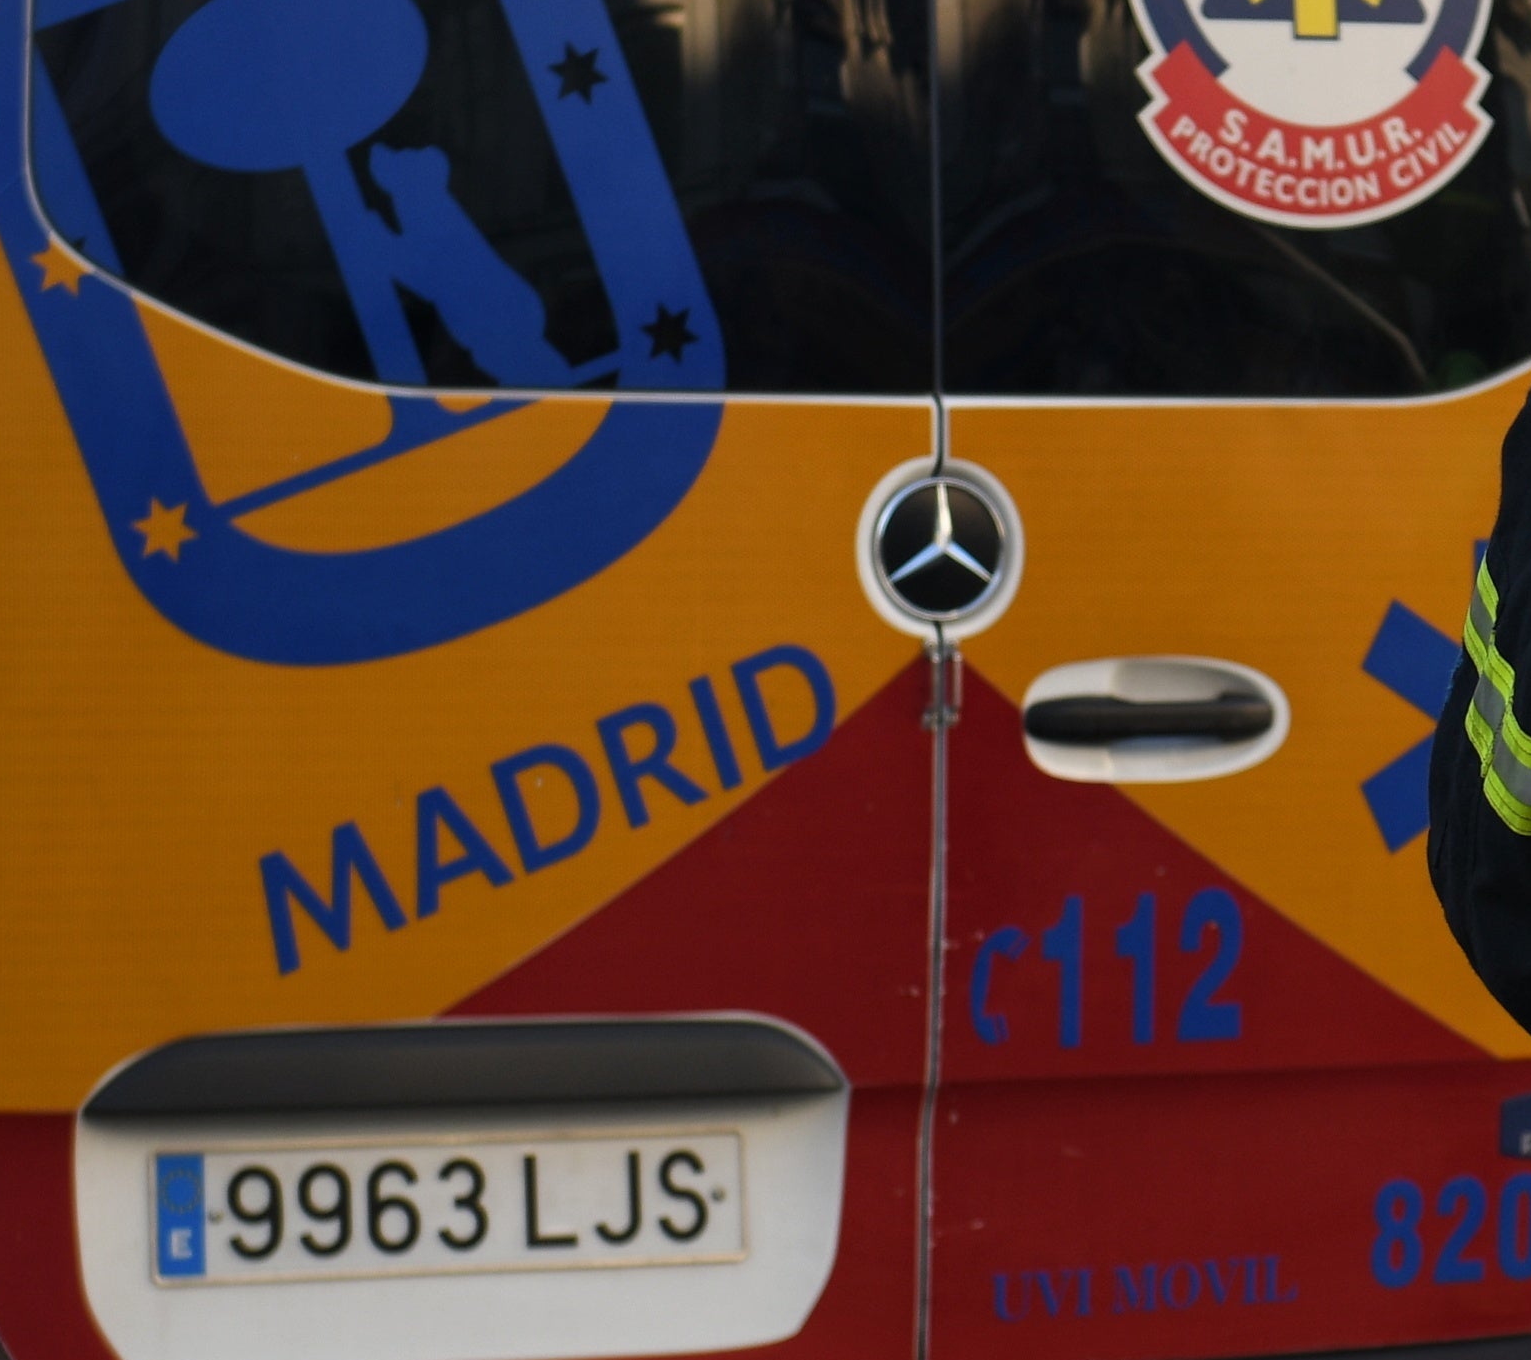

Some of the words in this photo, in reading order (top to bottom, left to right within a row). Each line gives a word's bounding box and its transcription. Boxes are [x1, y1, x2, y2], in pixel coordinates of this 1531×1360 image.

[1171, 115, 1382, 207] PROTECCION
[1388, 120, 1468, 190] CIVIL
[1218, 108, 1424, 171] S.A.M.U.R.
[259, 643, 838, 977] MADRID
[1041, 885, 1245, 1049] 112
[169, 1228, 193, 1260] E
[225, 1156, 490, 1261] 9963
[522, 1148, 709, 1249] LJS
[992, 1268, 1092, 1322] UVI
[1112, 1253, 1299, 1315] MOVIL
